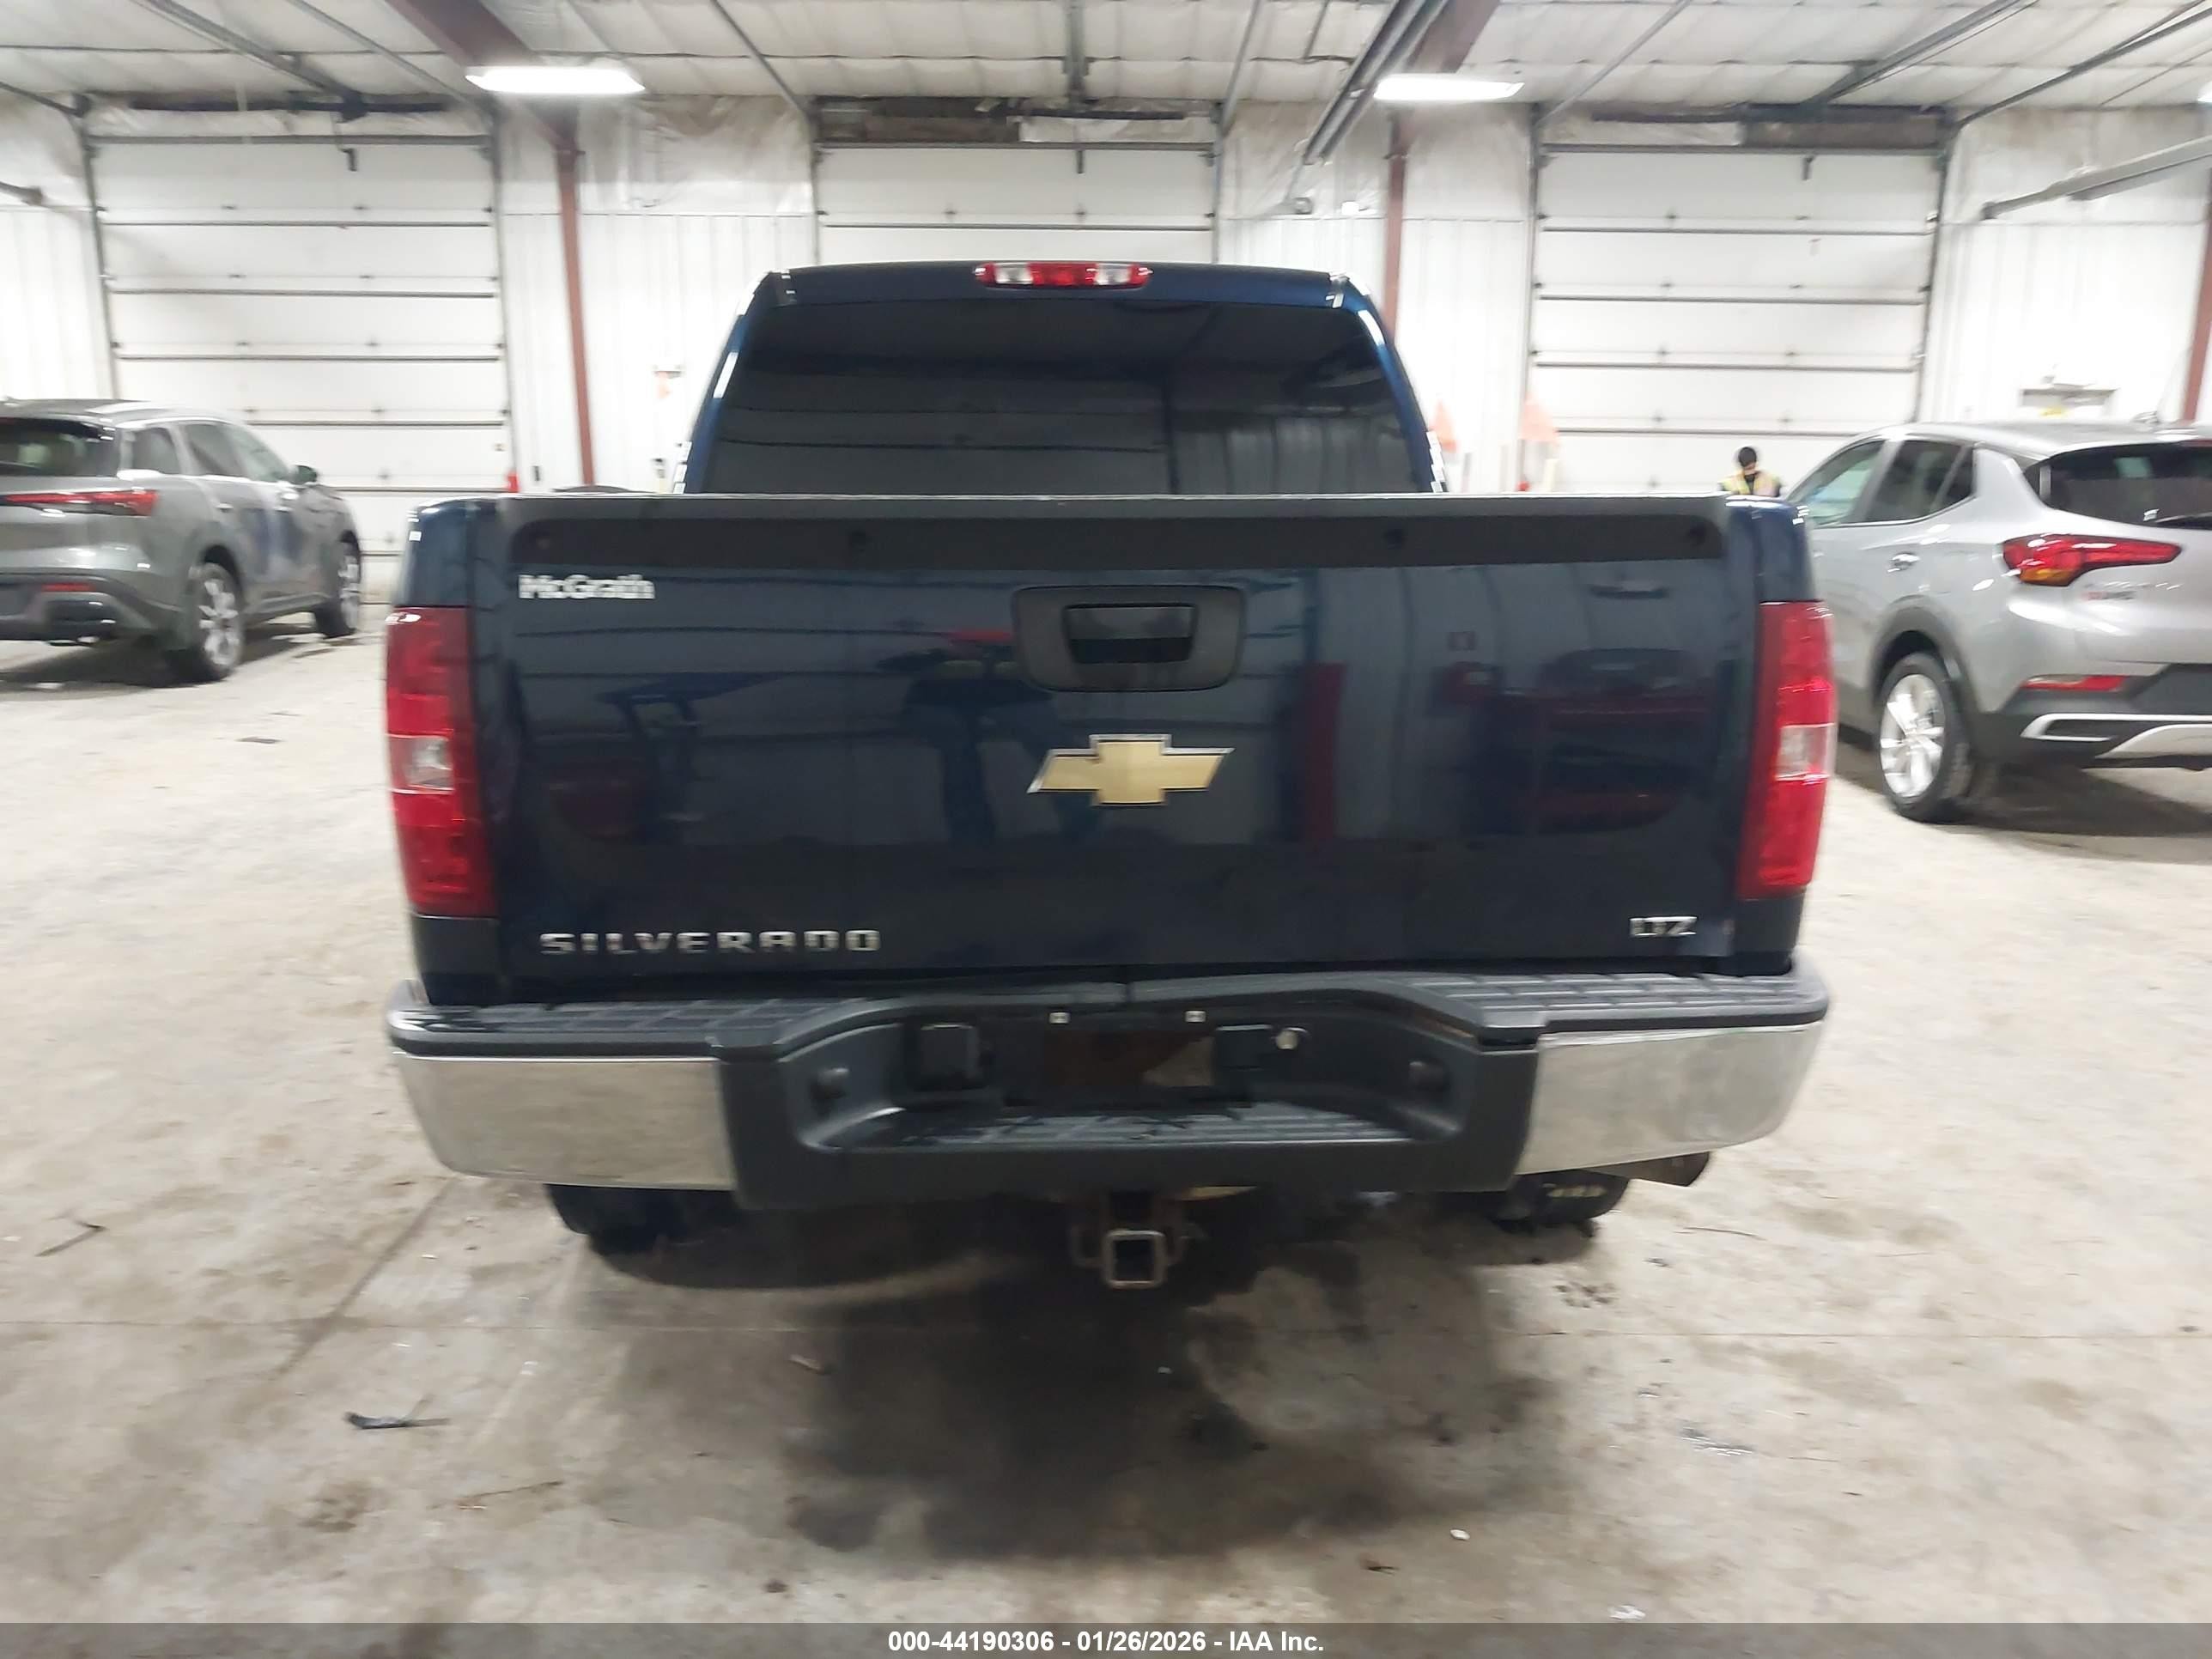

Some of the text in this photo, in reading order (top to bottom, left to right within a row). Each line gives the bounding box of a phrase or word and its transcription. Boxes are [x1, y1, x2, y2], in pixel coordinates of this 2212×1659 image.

[519, 574, 655, 599] McGrath
[1629, 915, 1698, 937] LTZ
[539, 930, 881, 955] SILVERADO
